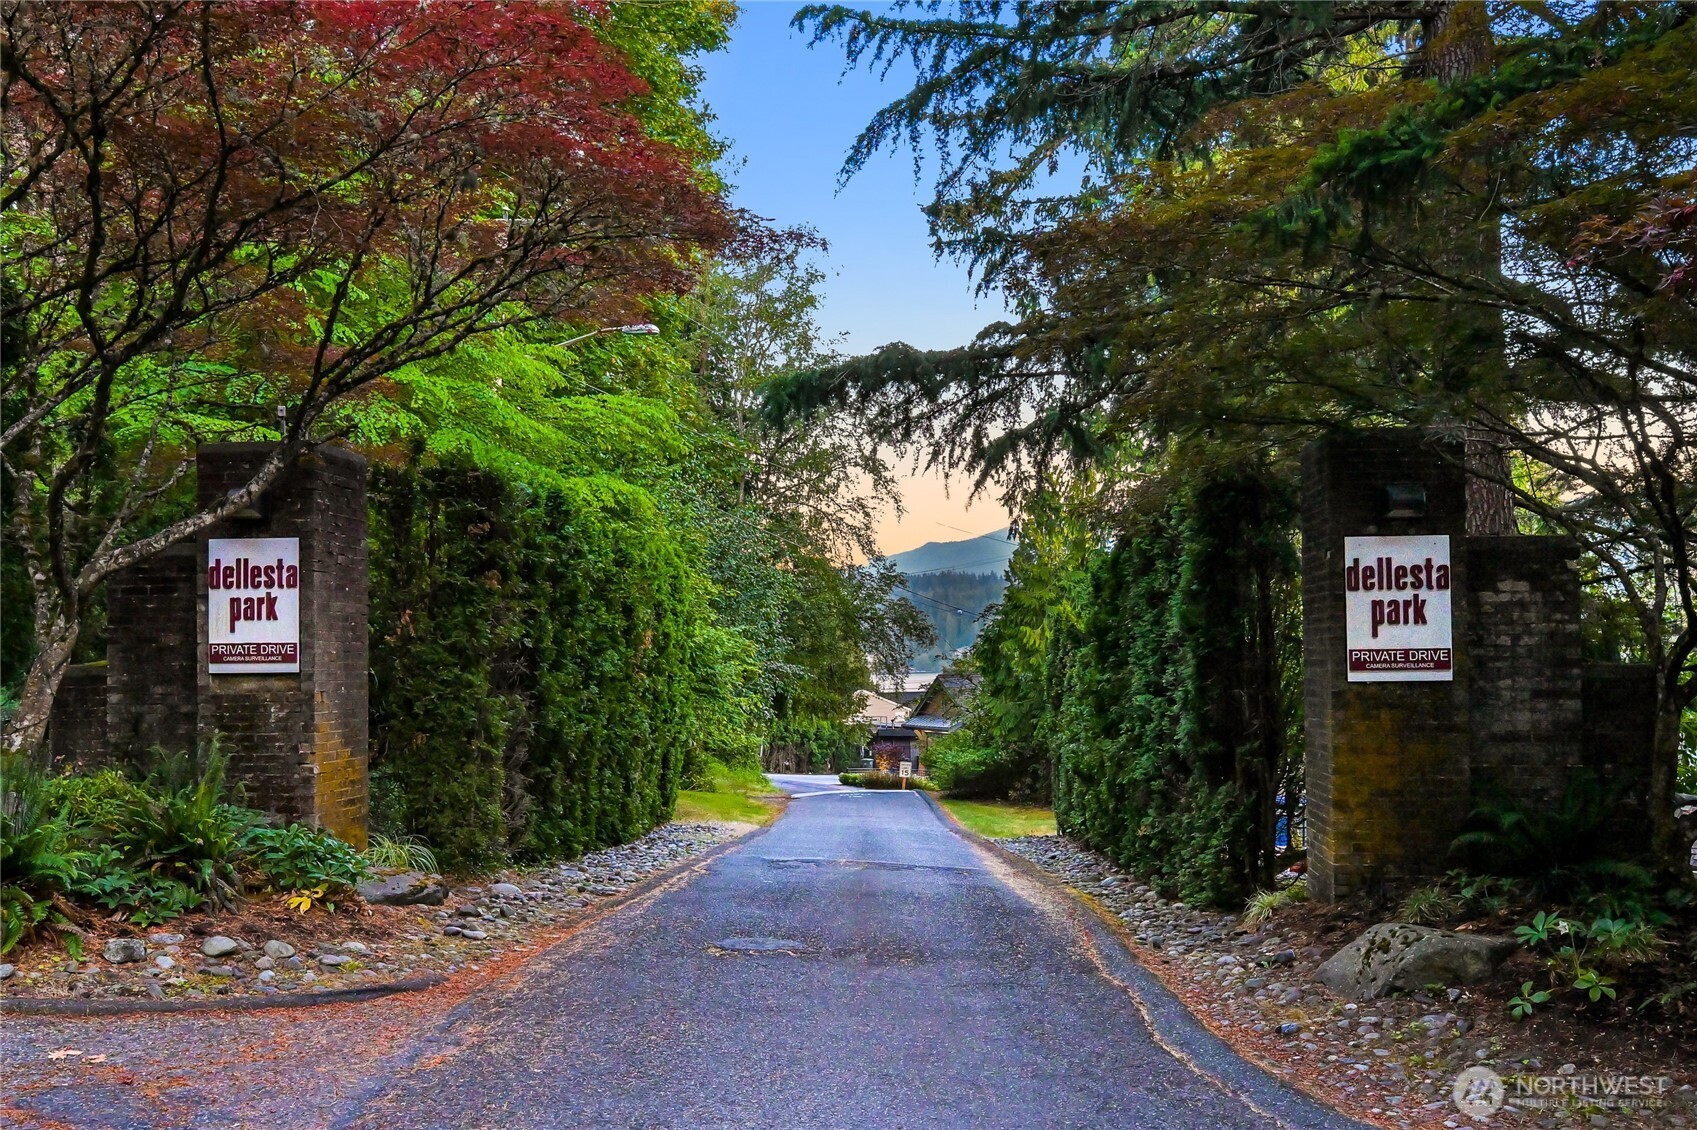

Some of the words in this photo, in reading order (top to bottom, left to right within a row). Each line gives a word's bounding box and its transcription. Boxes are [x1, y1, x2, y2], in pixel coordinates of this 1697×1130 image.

[208, 558, 298, 590] dellesta
[1346, 557, 1450, 591] dellesta
[229, 591, 279, 633] park
[1371, 593, 1428, 638] park
[211, 644, 257, 655] PRIVATE
[260, 644, 295, 654] DRIVE
[1352, 650, 1405, 661] PRIVATE
[1409, 650, 1449, 661] DRIVE
